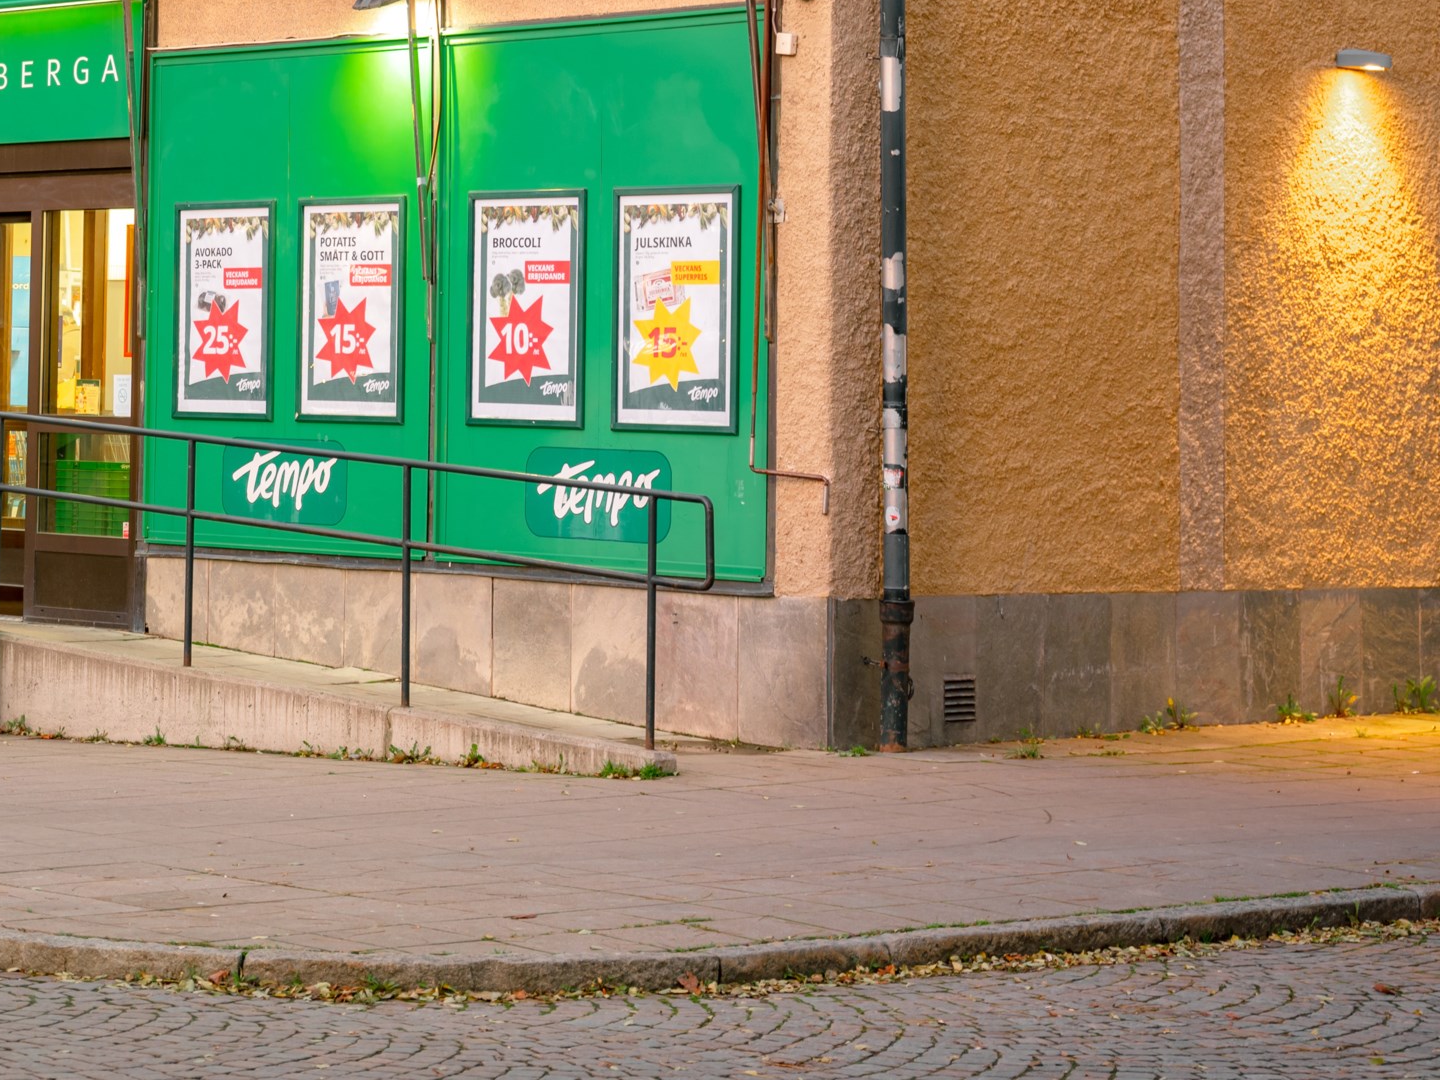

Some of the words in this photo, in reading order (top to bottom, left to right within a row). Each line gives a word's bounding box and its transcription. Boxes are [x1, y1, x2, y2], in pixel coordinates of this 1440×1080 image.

[320, 236, 357, 247] POTATIS
[492, 237, 542, 248] BROCCOLI
[635, 236, 692, 251] JULSKINKA
[195, 247, 233, 257] AVOKADO
[320, 249, 350, 262] SMÅTT
[351, 250, 358, 261] &
[360, 250, 385, 261] GOTT
[195, 259, 222, 269] 3-PACK
[527, 264, 555, 272] VECKANS
[674, 264, 702, 272] VECKANS
[527, 272, 565, 282] ERBJUDANDE
[674, 273, 708, 281] SUPERPRIS
